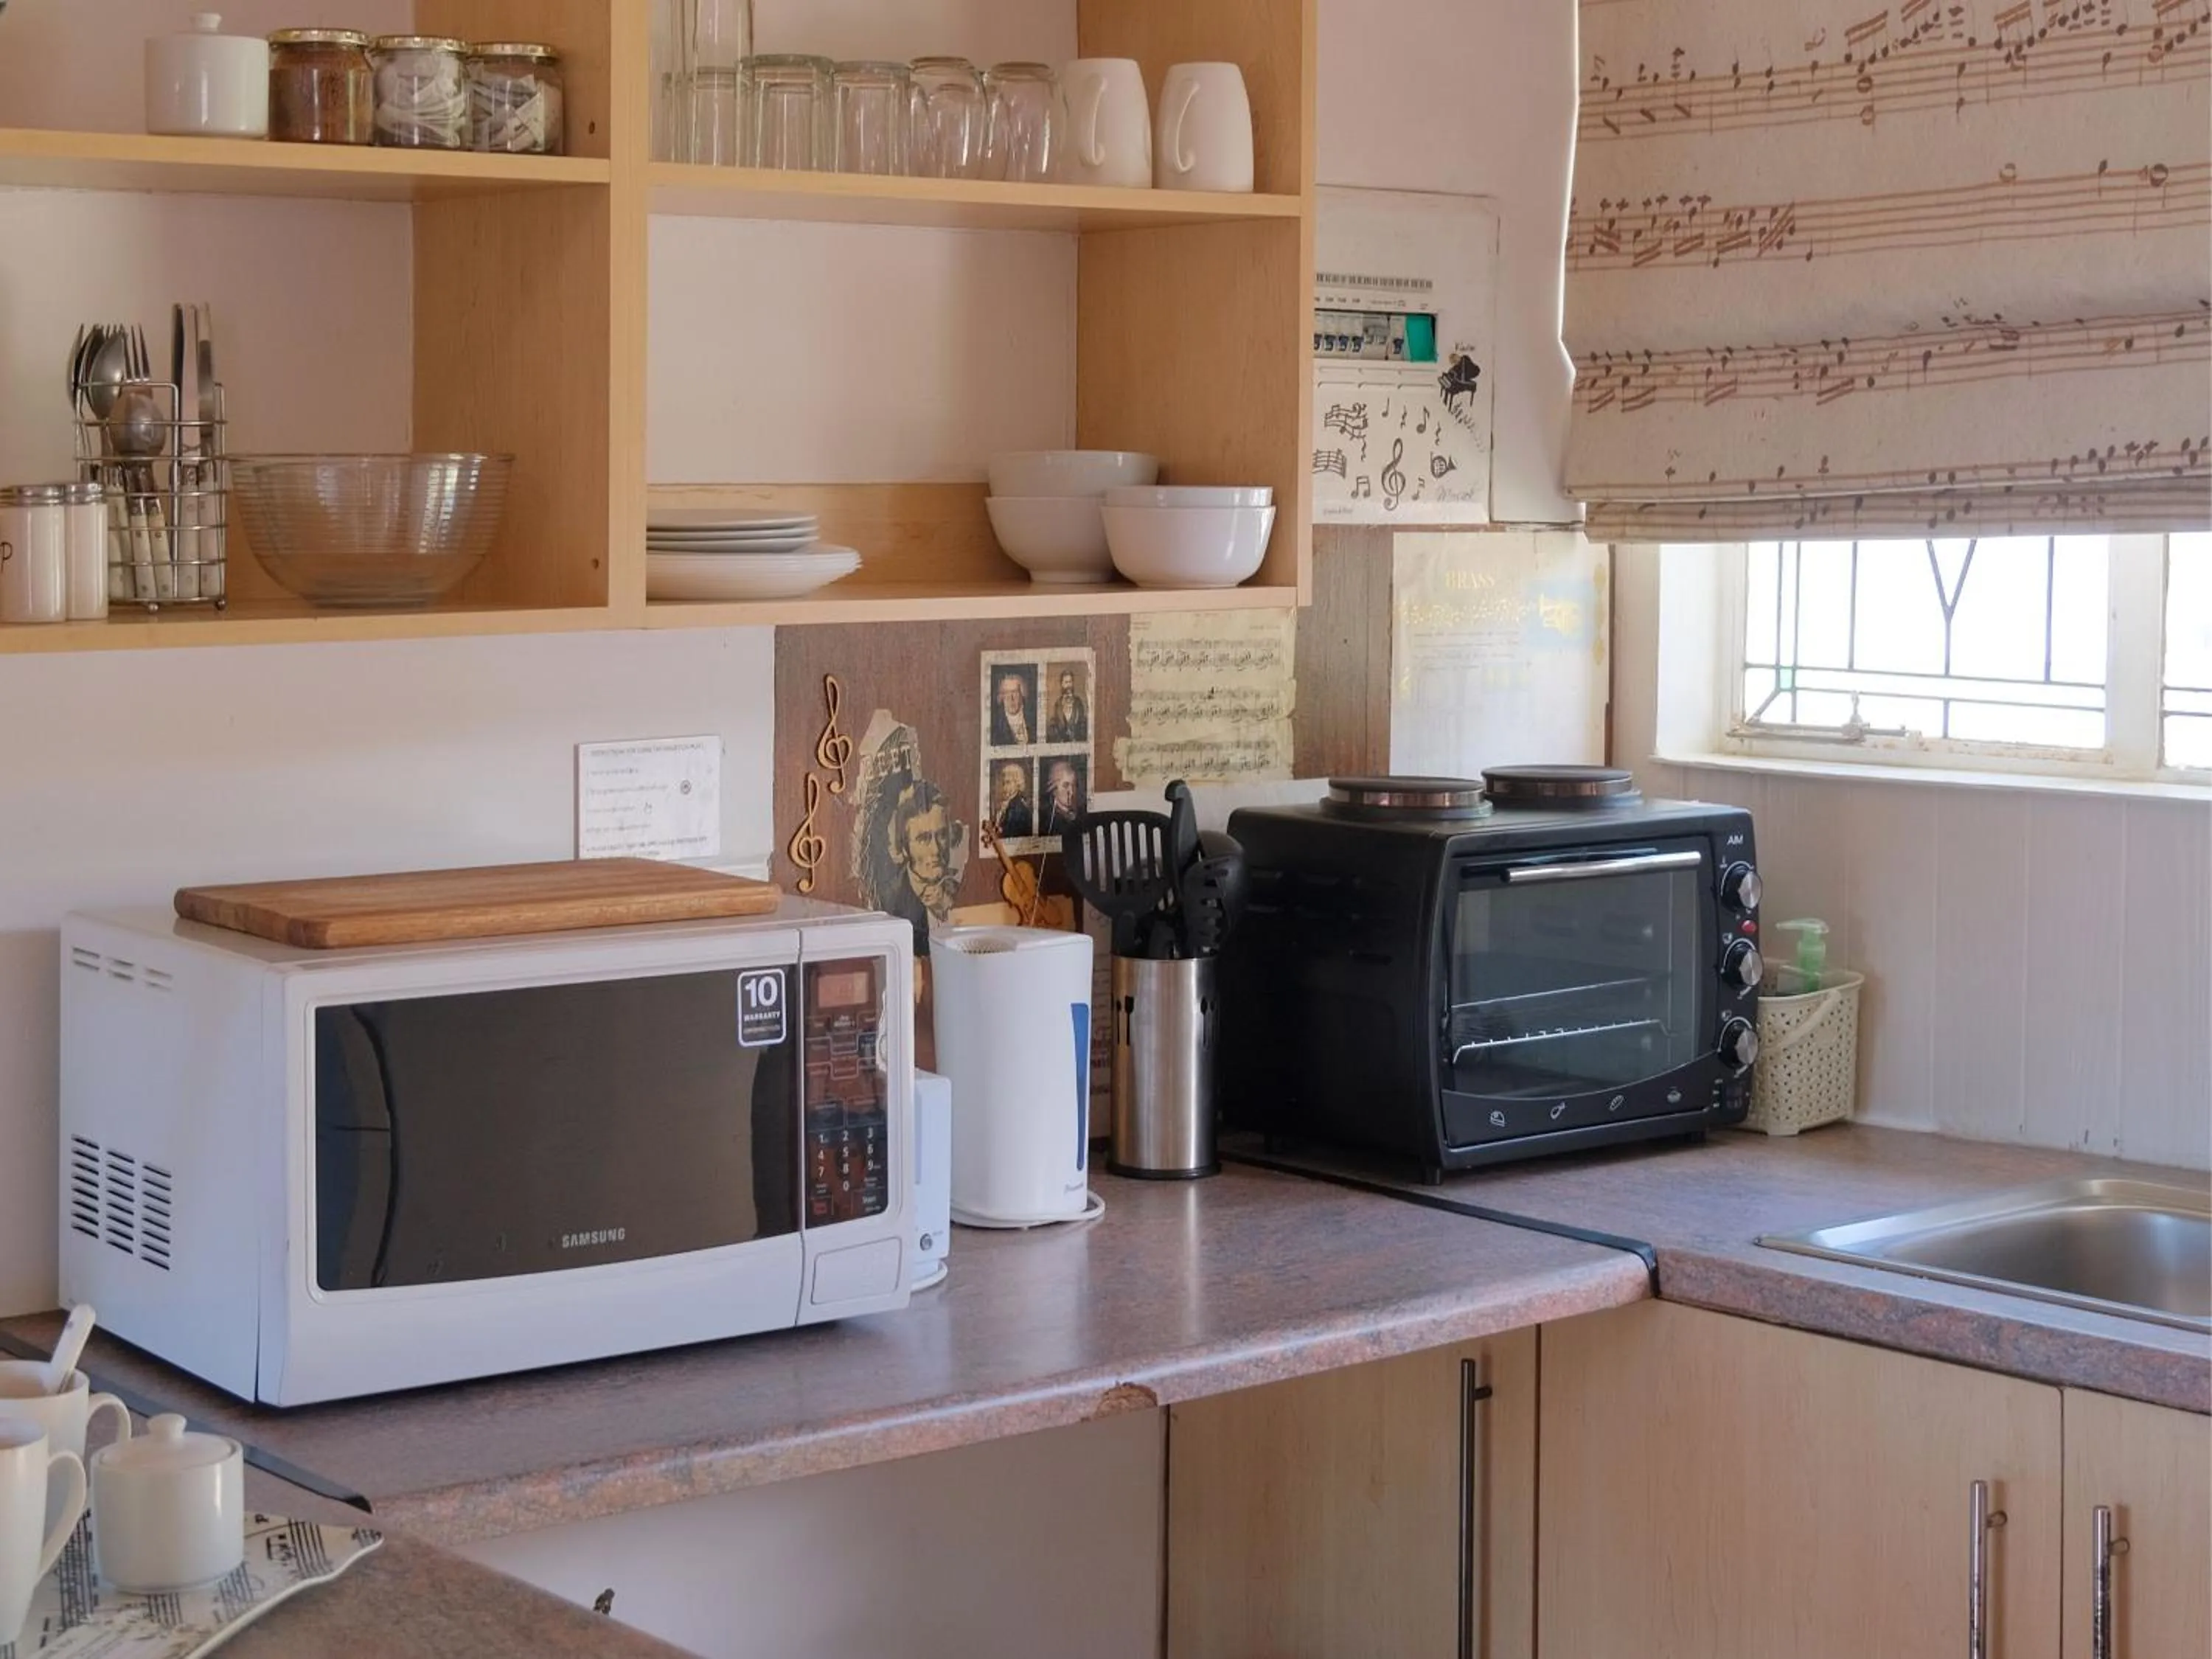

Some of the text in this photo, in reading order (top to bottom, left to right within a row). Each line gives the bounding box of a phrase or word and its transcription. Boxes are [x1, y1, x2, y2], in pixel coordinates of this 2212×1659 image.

[1445, 571, 1495, 589] BRASS
[745, 976, 778, 1008] 10
[818, 1134, 824, 1143] 1
[843, 1130, 849, 1141] 2
[818, 1144, 874, 1161] 4 5 6
[818, 1159, 874, 1178] 7 8 9
[843, 1180, 849, 1192] 0
[562, 1228, 625, 1248] SAMSUNG
